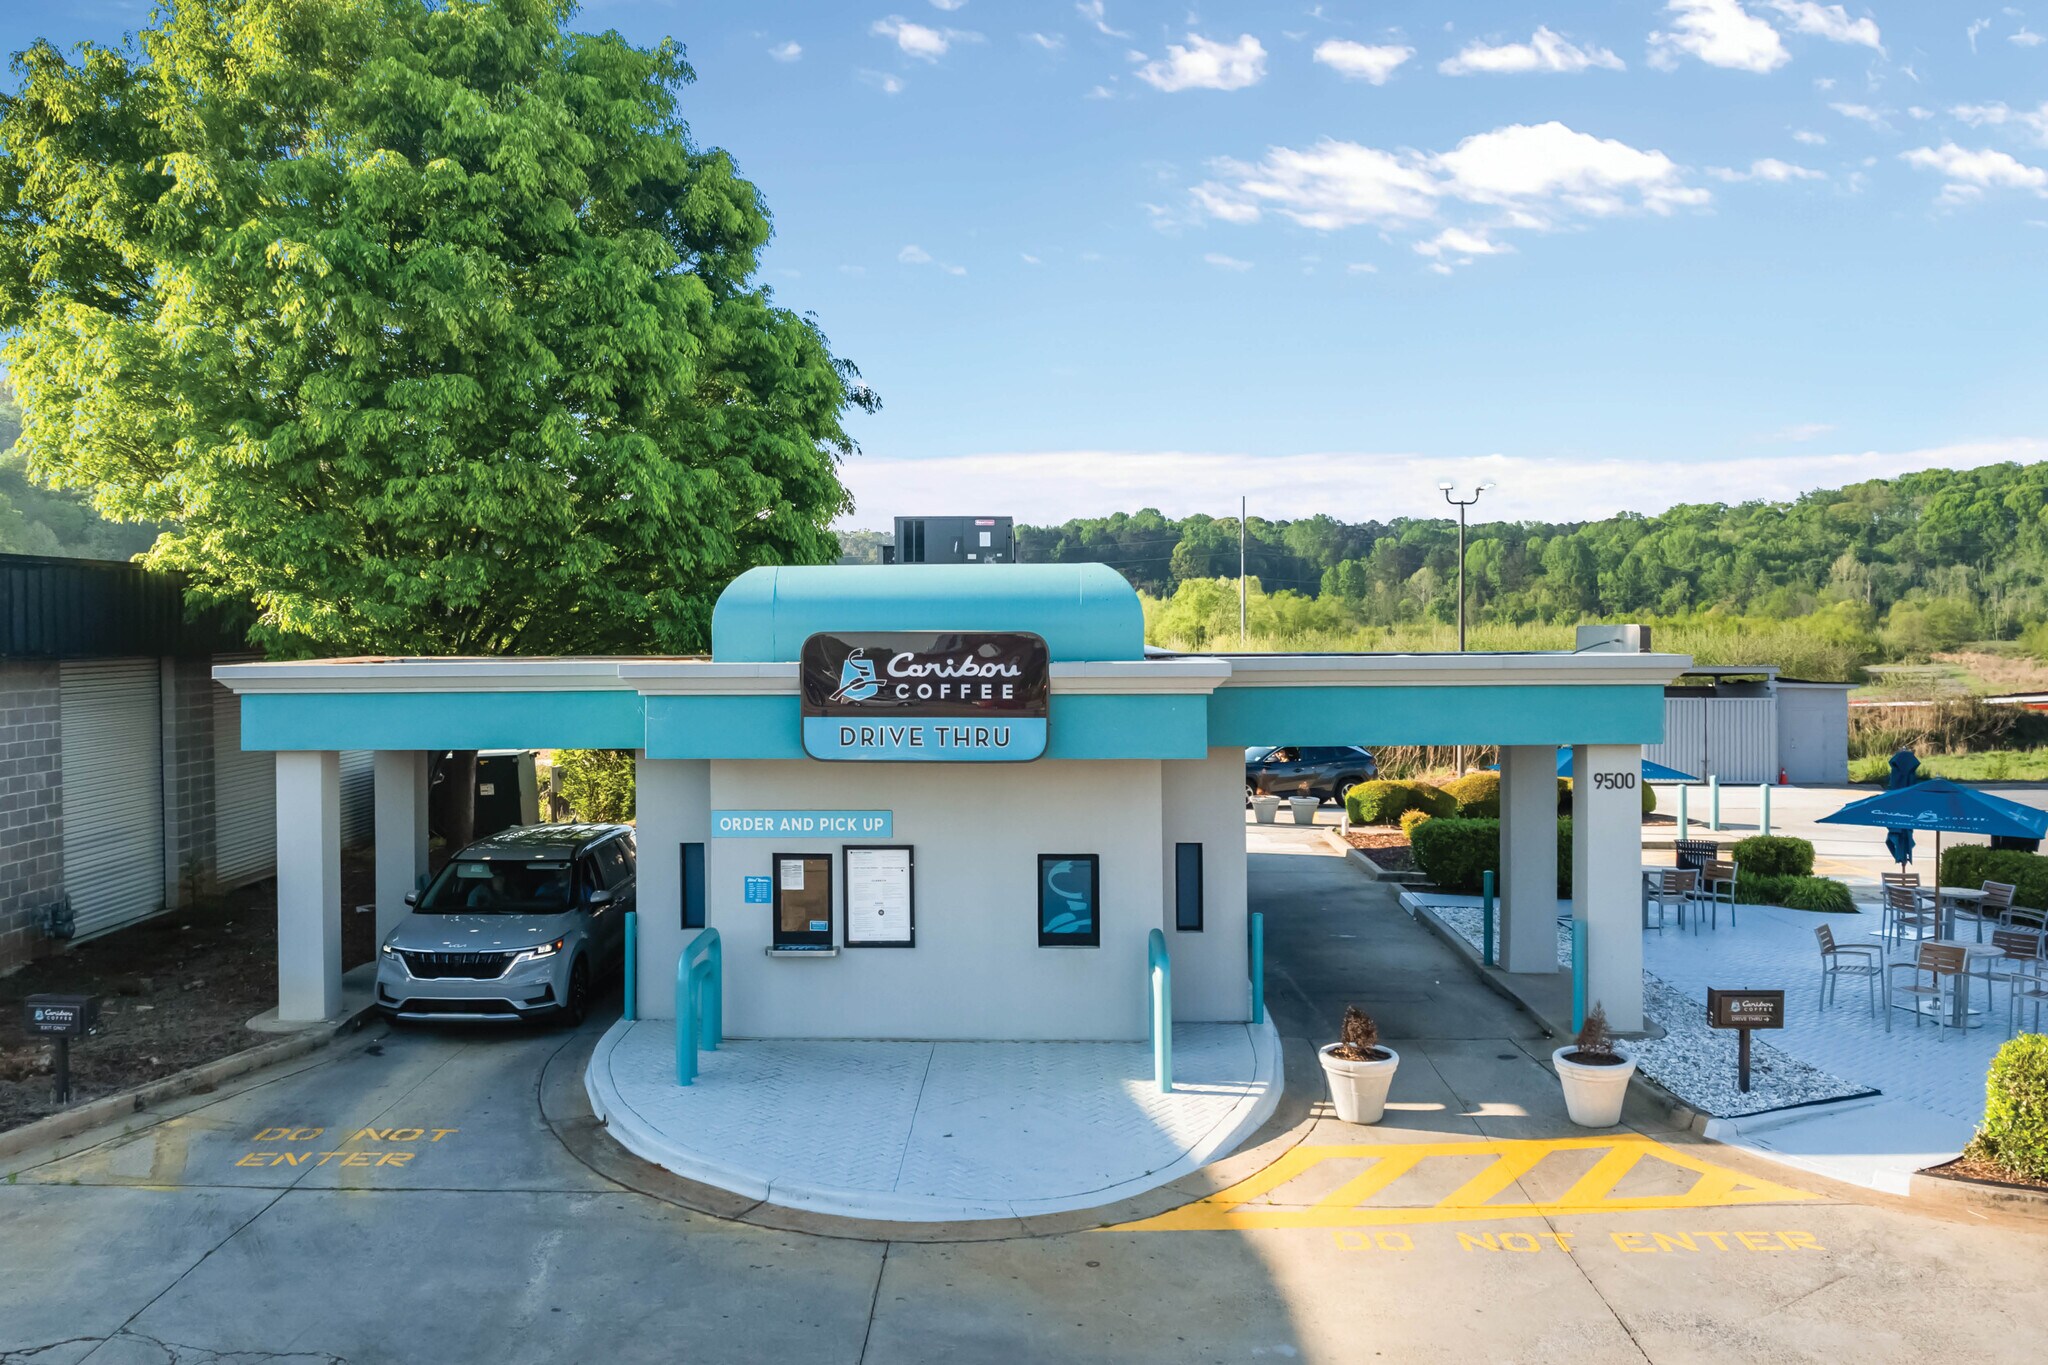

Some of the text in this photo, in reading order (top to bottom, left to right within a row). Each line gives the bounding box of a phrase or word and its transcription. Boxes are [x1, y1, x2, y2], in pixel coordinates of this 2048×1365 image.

[887, 652, 1022, 678] Caribou
[895, 683, 1014, 700] COFFEE
[839, 726, 1011, 748] DRIVE THRU
[1593, 772, 1635, 790] 9500
[719, 817, 884, 831] ORDER AND PICK UP
[44, 1008, 73, 1016] Caribou
[1742, 1000, 1774, 1008] Caribou
[253, 1127, 461, 1142] DO NOT
[234, 1152, 416, 1167] ENTER
[1331, 1231, 1827, 1253] DO NOT ENTER
